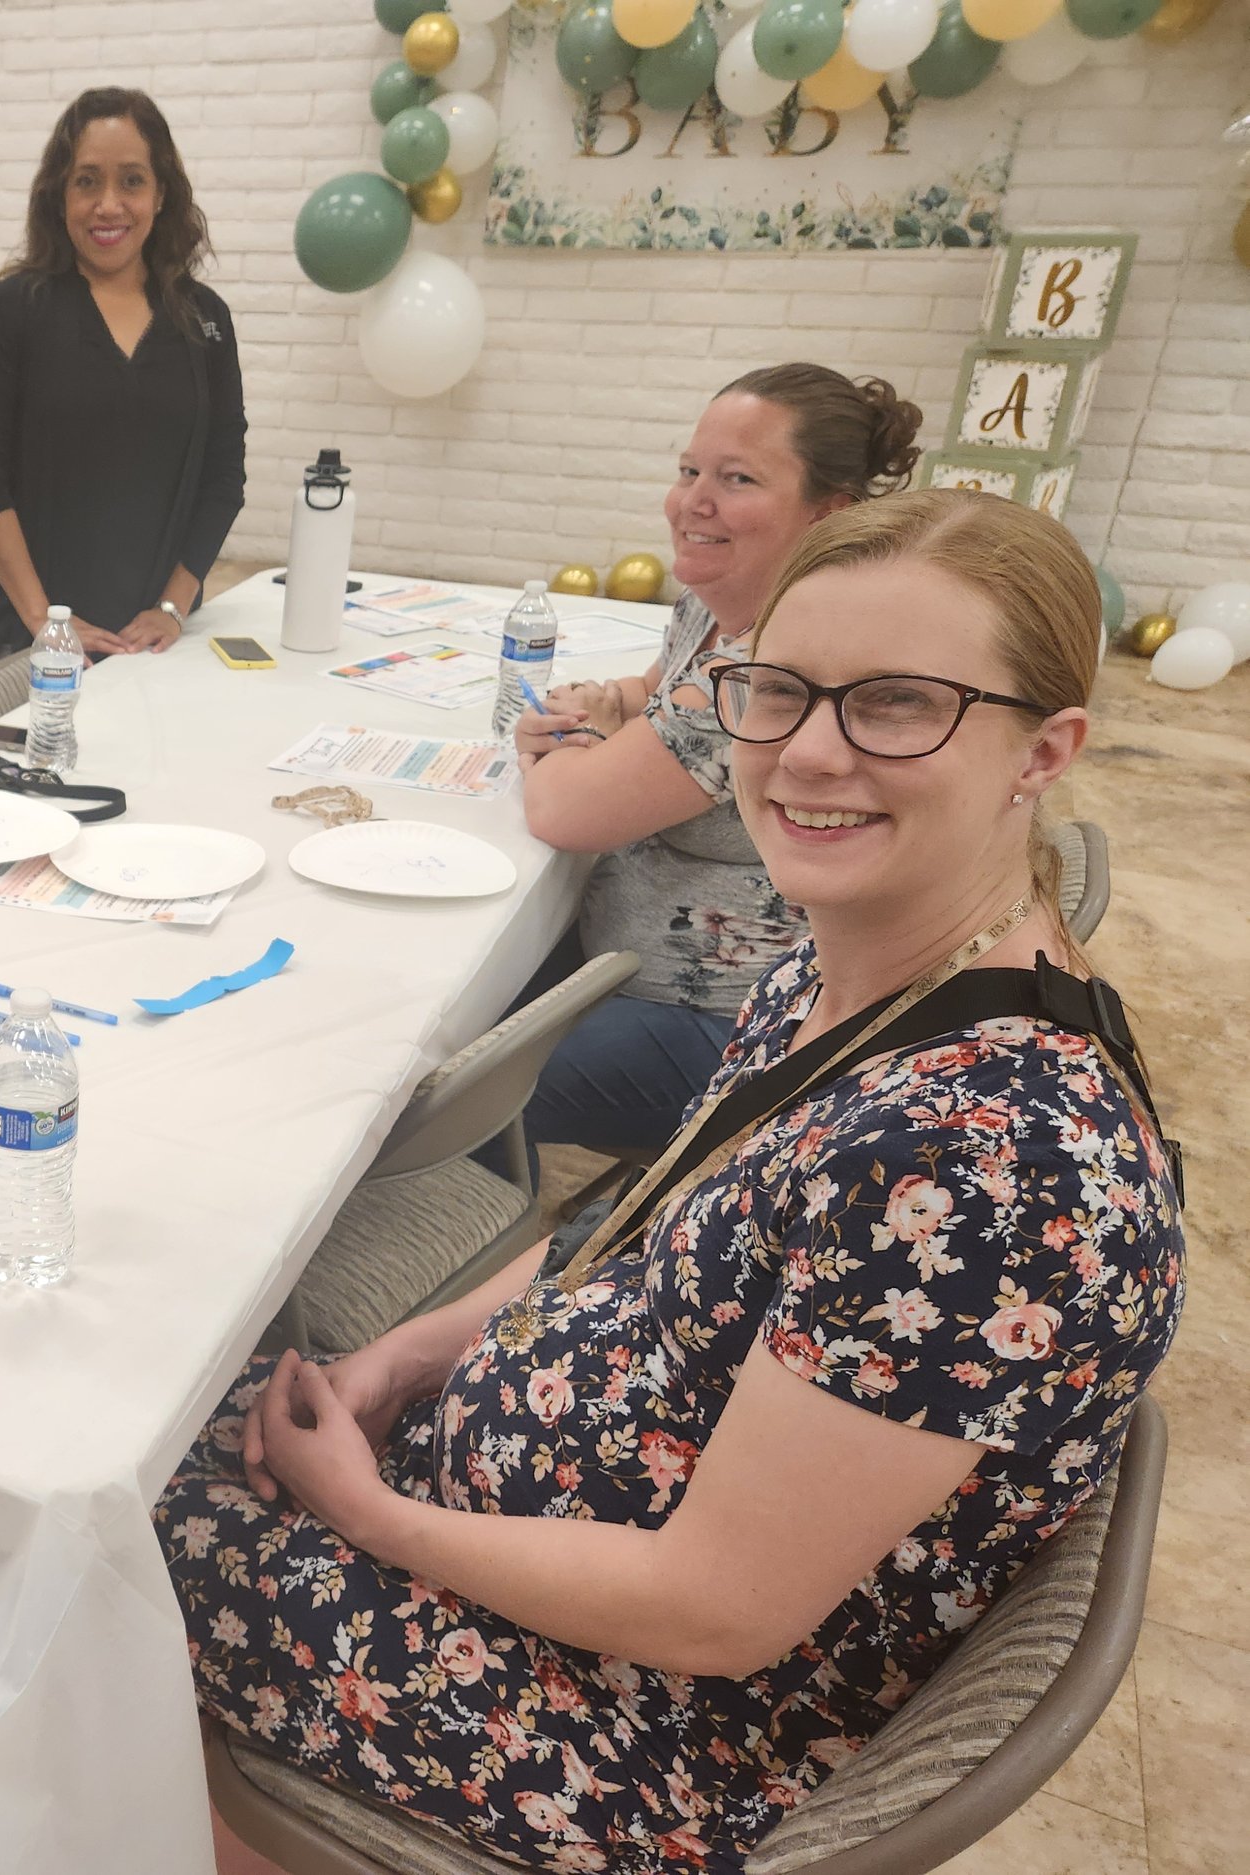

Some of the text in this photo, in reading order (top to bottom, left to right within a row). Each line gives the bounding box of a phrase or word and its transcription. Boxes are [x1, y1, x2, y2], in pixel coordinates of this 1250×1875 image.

[570, 76, 920, 158] BABY
[1037, 258, 1087, 329] B
[979, 372, 1032, 440] A
